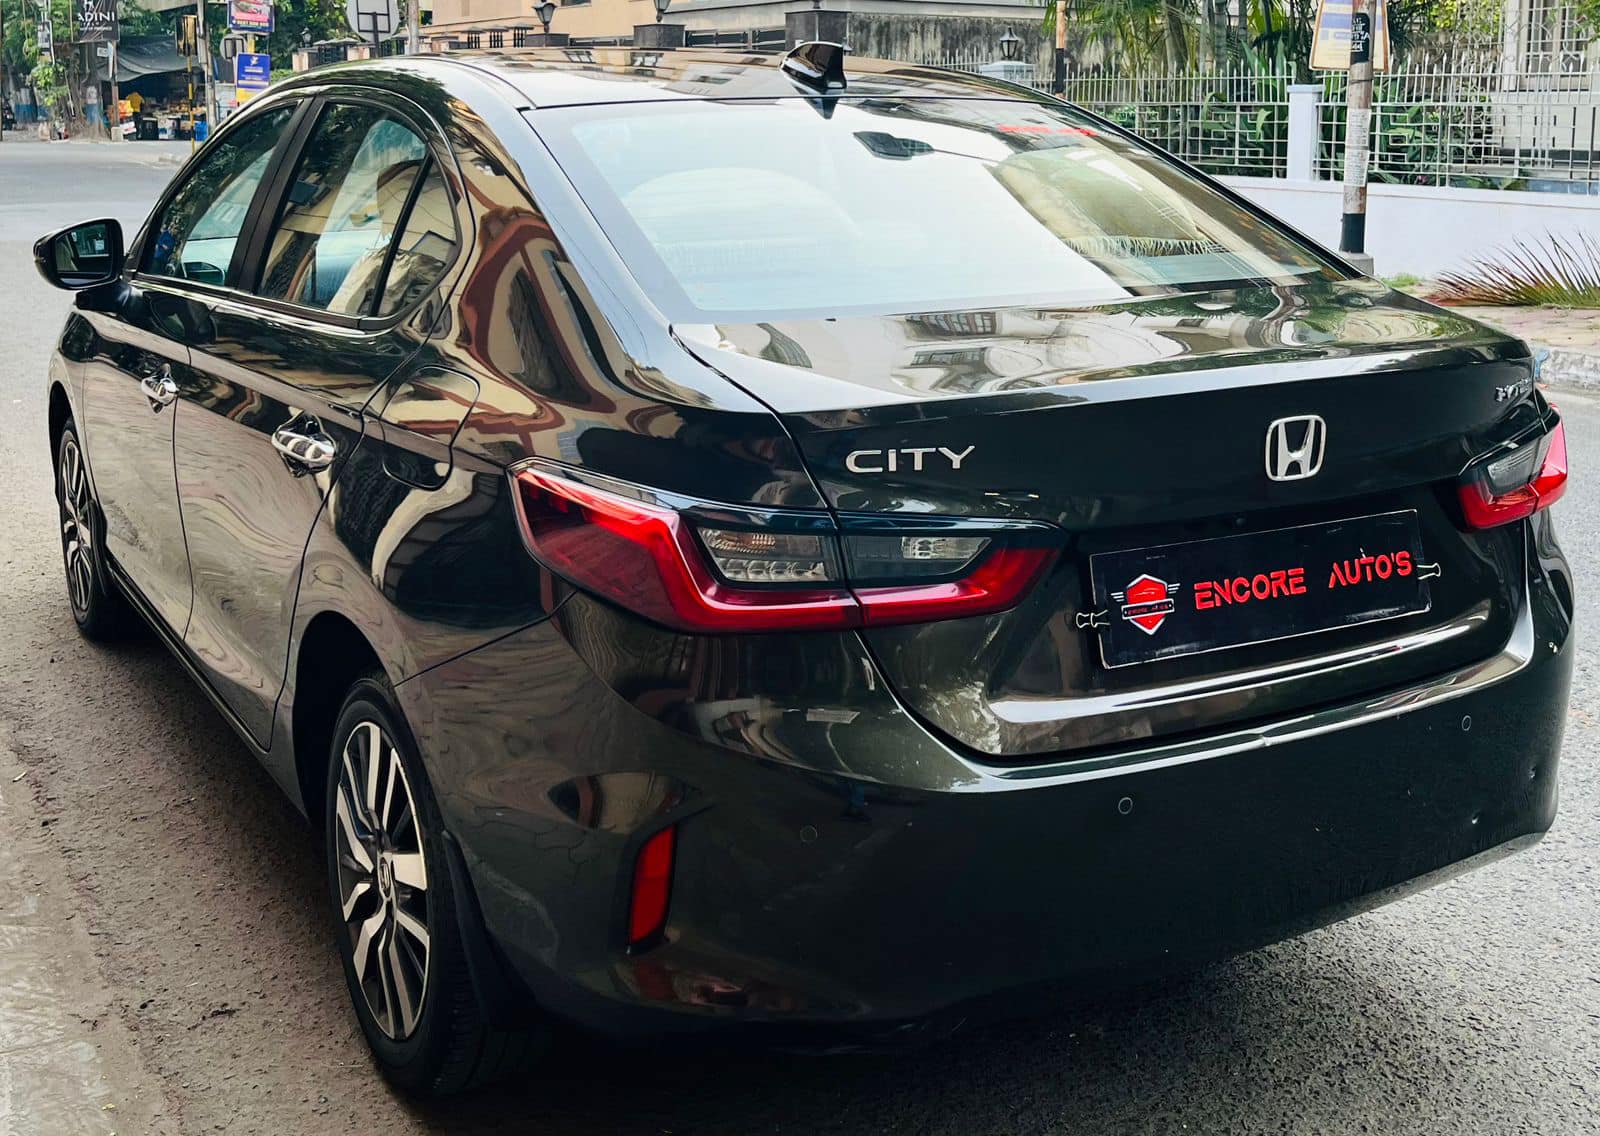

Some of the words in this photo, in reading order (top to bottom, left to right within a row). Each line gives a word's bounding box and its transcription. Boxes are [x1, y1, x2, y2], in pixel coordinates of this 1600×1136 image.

[845, 445, 976, 473] CITY
[1193, 567, 1307, 610] ENCORE
[1328, 550, 1413, 589] AUTO'S
